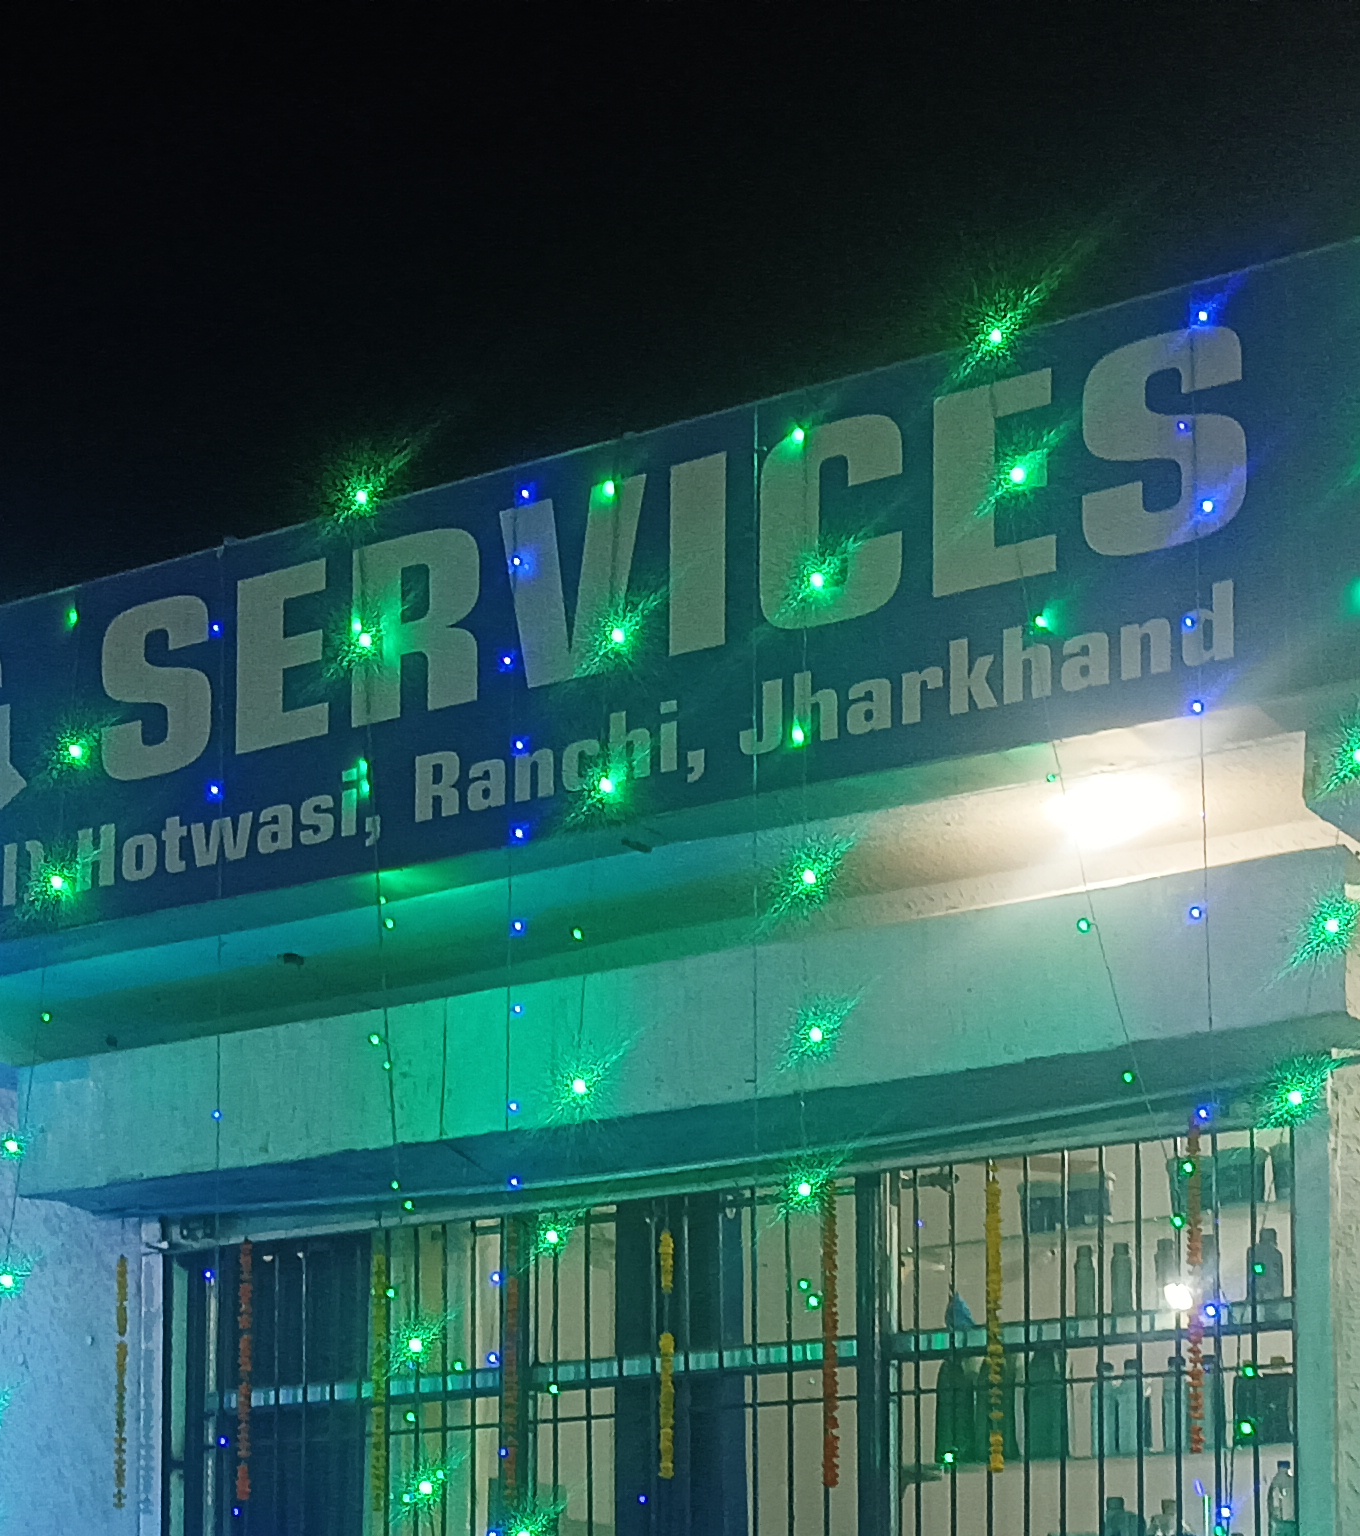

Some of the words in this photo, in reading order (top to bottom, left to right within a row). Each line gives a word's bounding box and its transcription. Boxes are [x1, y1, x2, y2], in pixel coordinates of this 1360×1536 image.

[77, 760, 382, 891] Hotwasi,
[414, 700, 705, 824] Ranchi,
[739, 579, 1235, 756] Jharkhand
[100, 324, 1248, 781] SERVICES
